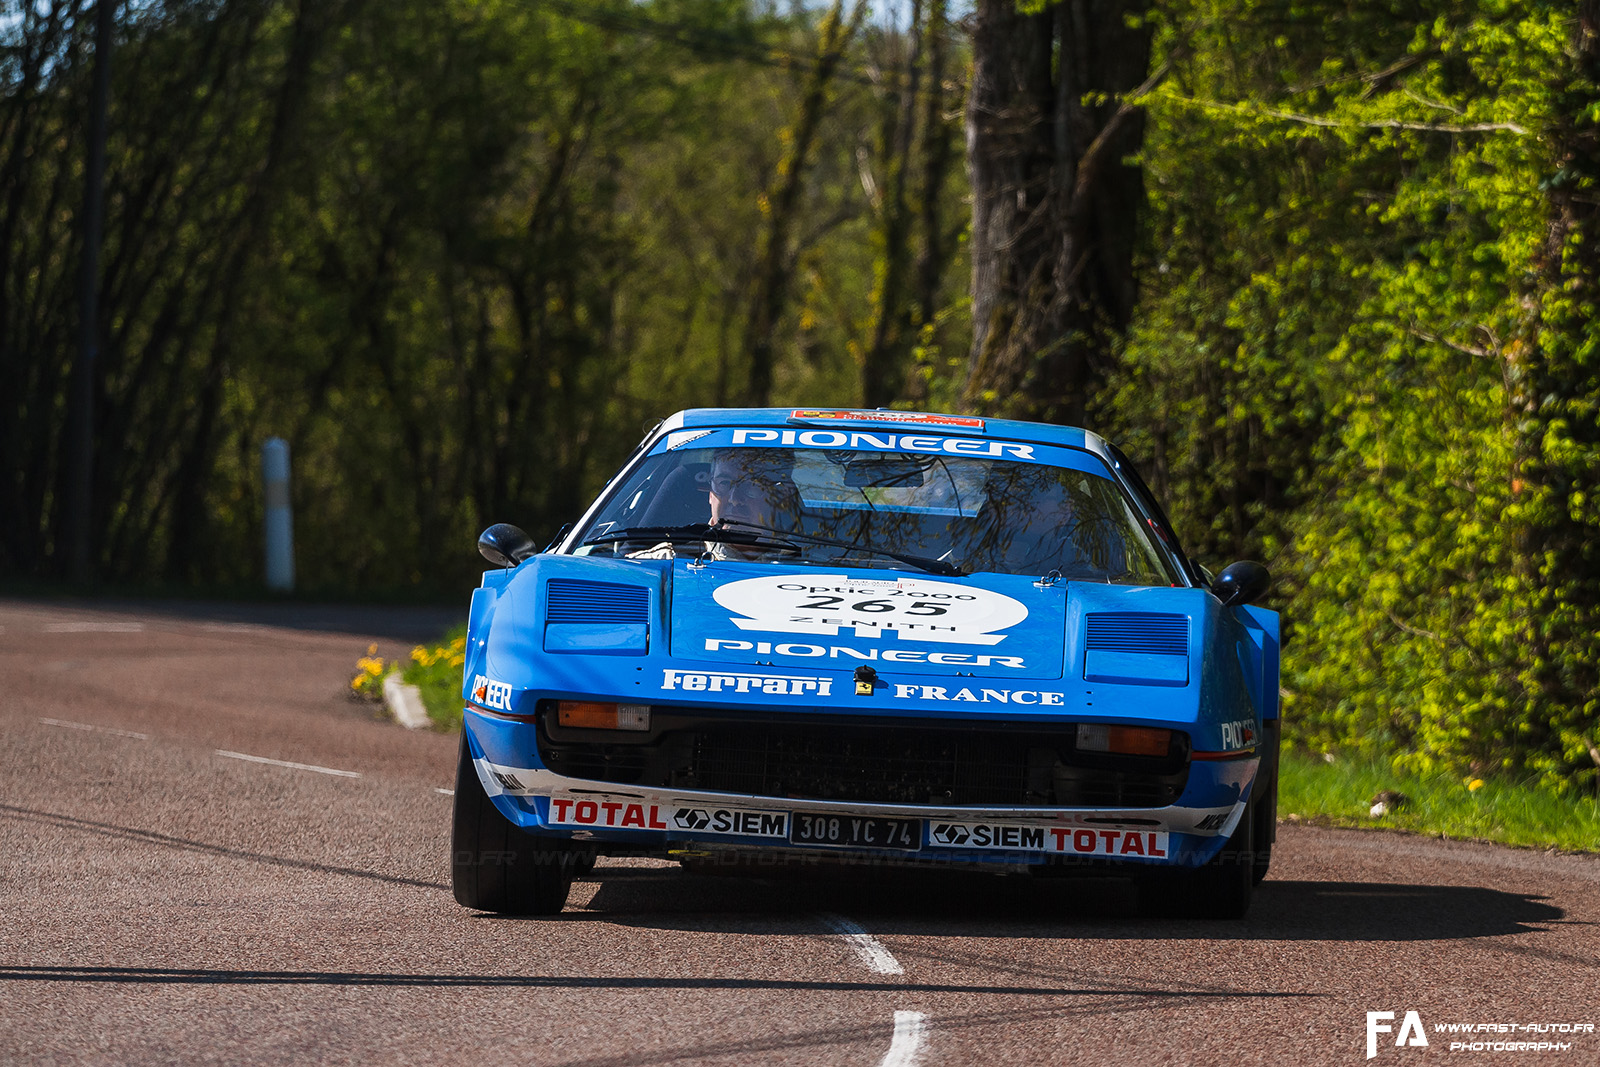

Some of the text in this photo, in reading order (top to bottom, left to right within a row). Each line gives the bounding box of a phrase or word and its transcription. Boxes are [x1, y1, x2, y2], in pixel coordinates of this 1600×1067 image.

[731, 429, 1036, 461] PIONEER
[777, 584, 875, 597] Optic
[887, 589, 978, 602] 2000
[795, 595, 952, 616] 265
[789, 616, 957, 632] ZENITH
[704, 638, 1027, 669] PIONEER
[660, 669, 834, 697] Ferrari
[893, 683, 1066, 707] FRANCE
[553, 799, 667, 829] TOTAL
[712, 809, 785, 836] SIEM
[801, 817, 912, 846] 308 YC 74
[972, 825, 1044, 849] SIEM
[1050, 828, 1166, 857] TOTAL
